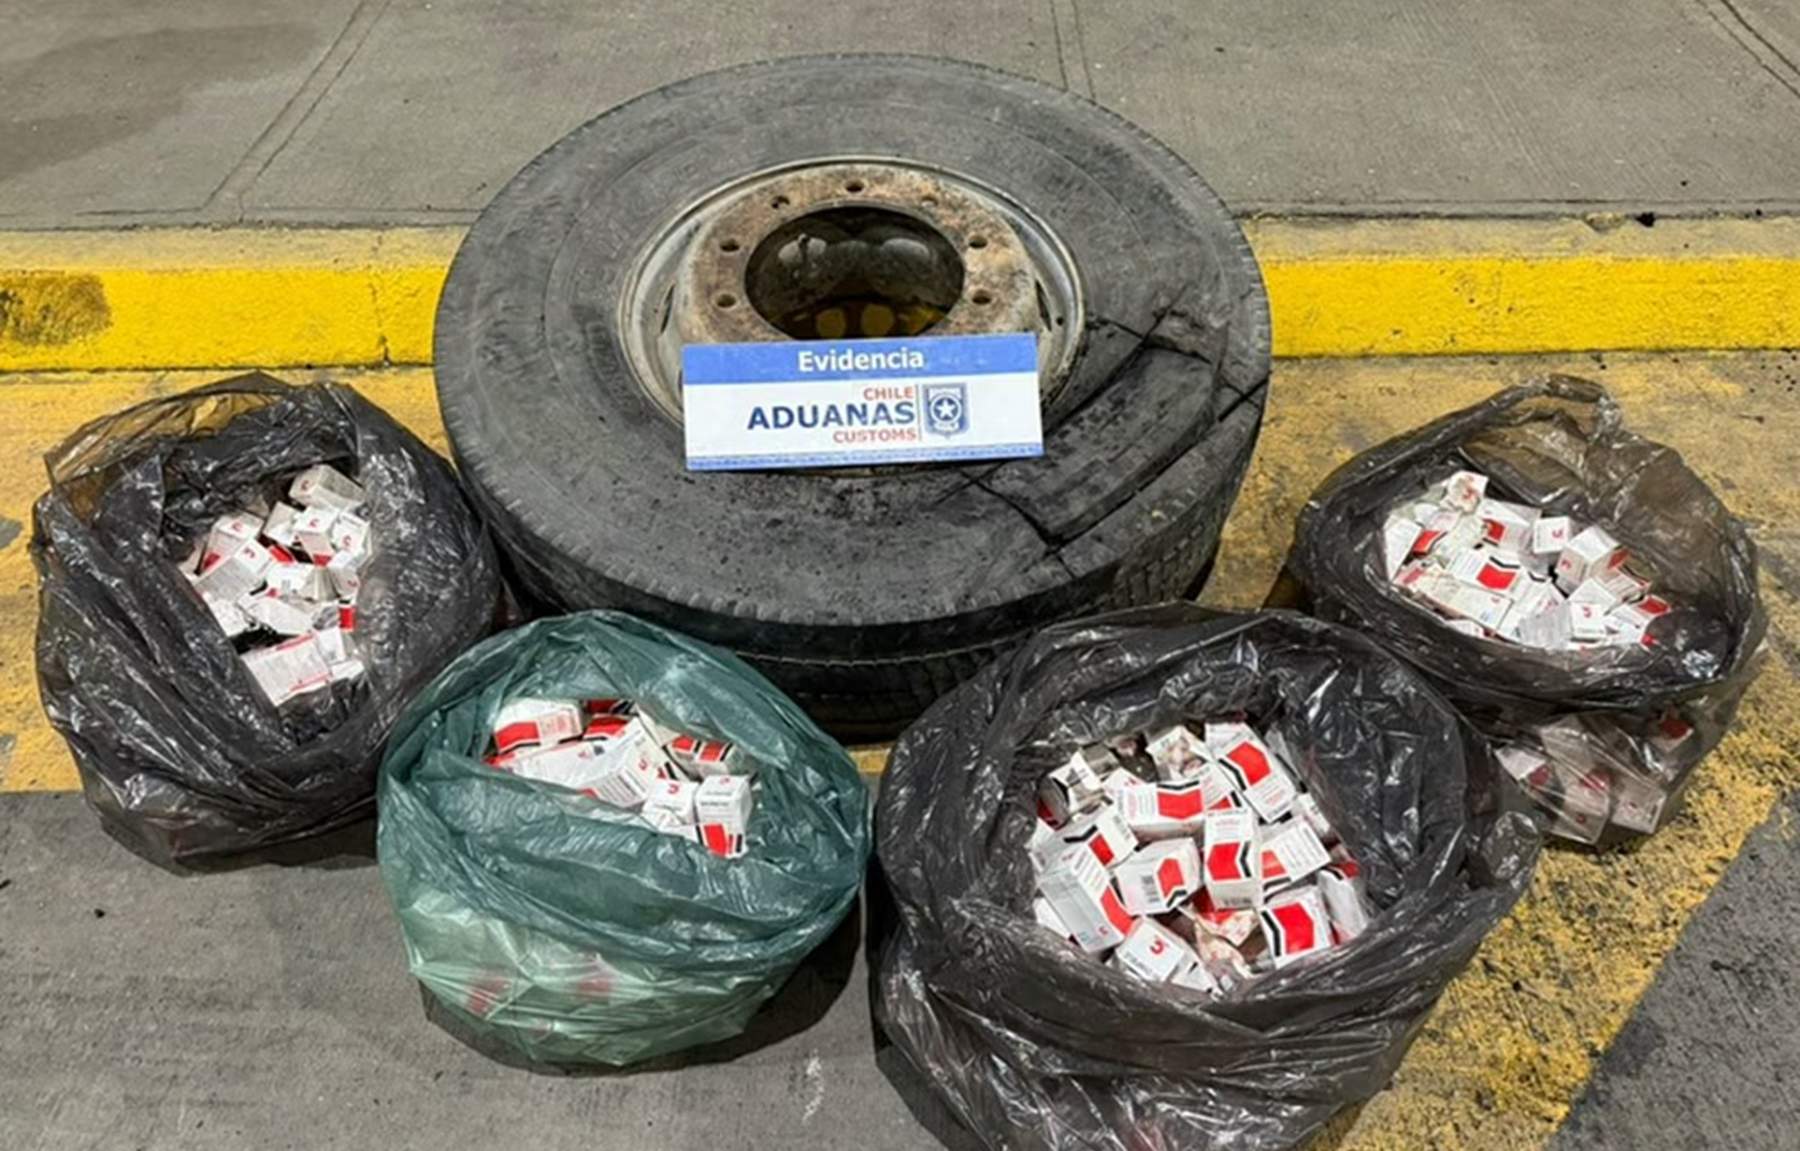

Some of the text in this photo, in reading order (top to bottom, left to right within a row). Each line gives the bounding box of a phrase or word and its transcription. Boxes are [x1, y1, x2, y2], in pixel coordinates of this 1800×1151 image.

[798, 347, 924, 372] Evidencia
[863, 386, 914, 401] CHILE
[747, 401, 915, 430] ADUANAS
[832, 428, 917, 444] CUSTOMS
